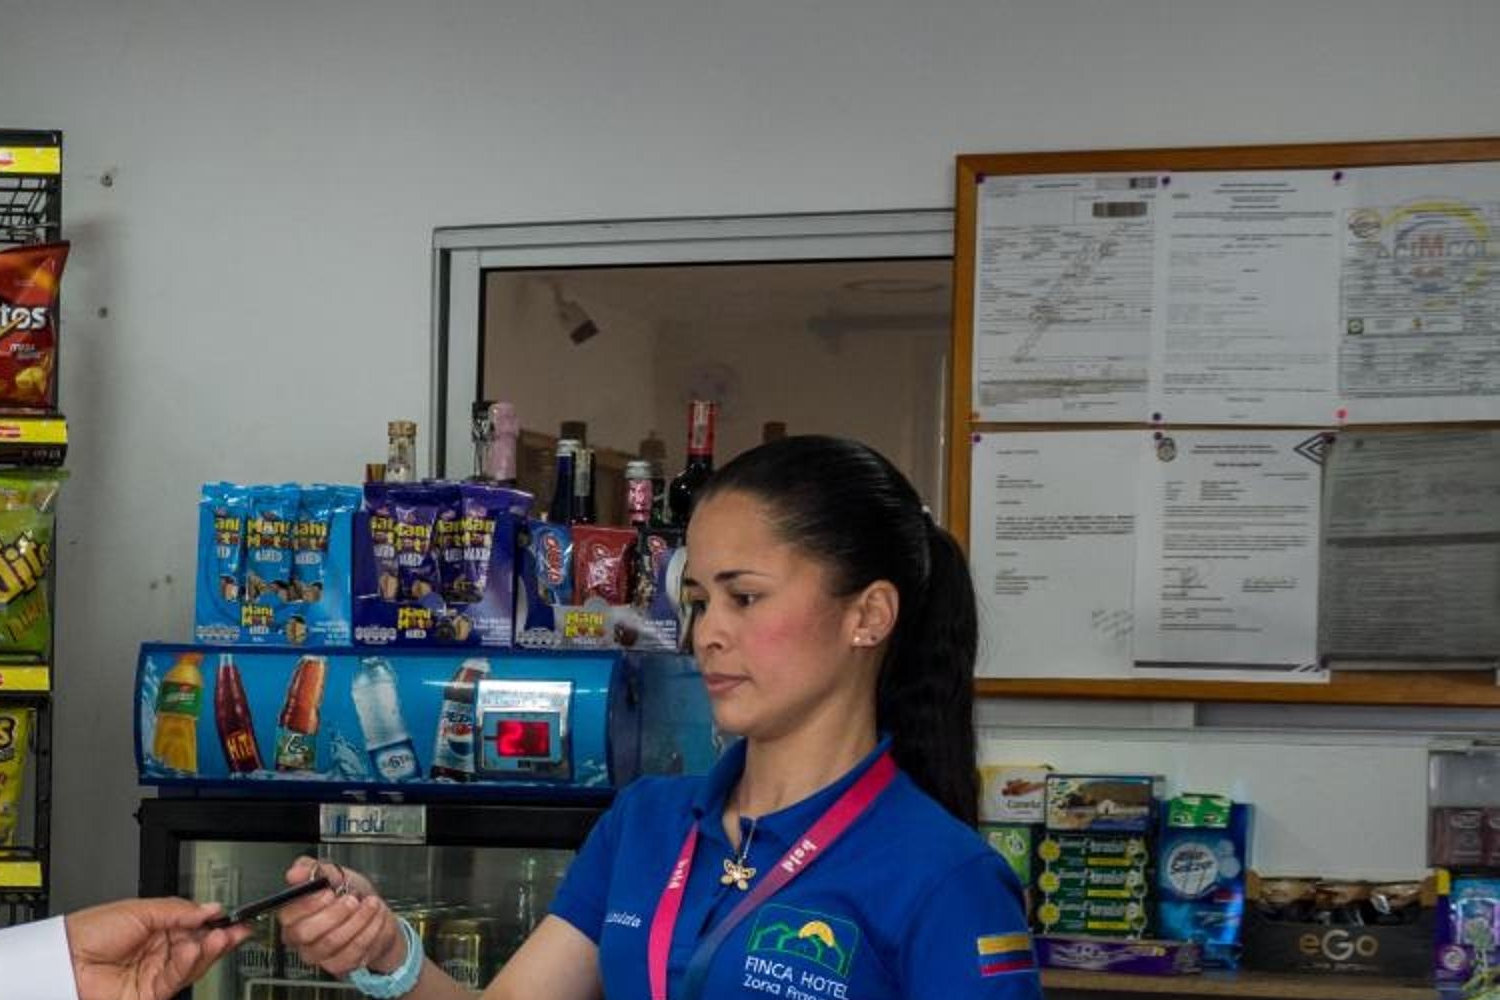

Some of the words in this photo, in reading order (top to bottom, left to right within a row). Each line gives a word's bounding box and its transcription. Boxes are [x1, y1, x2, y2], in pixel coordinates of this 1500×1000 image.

[1299, 928, 1380, 961] eGo
[742, 973, 782, 996] Zona
[744, 955, 794, 983] FINCA
[800, 971, 850, 1000] HOTEL
